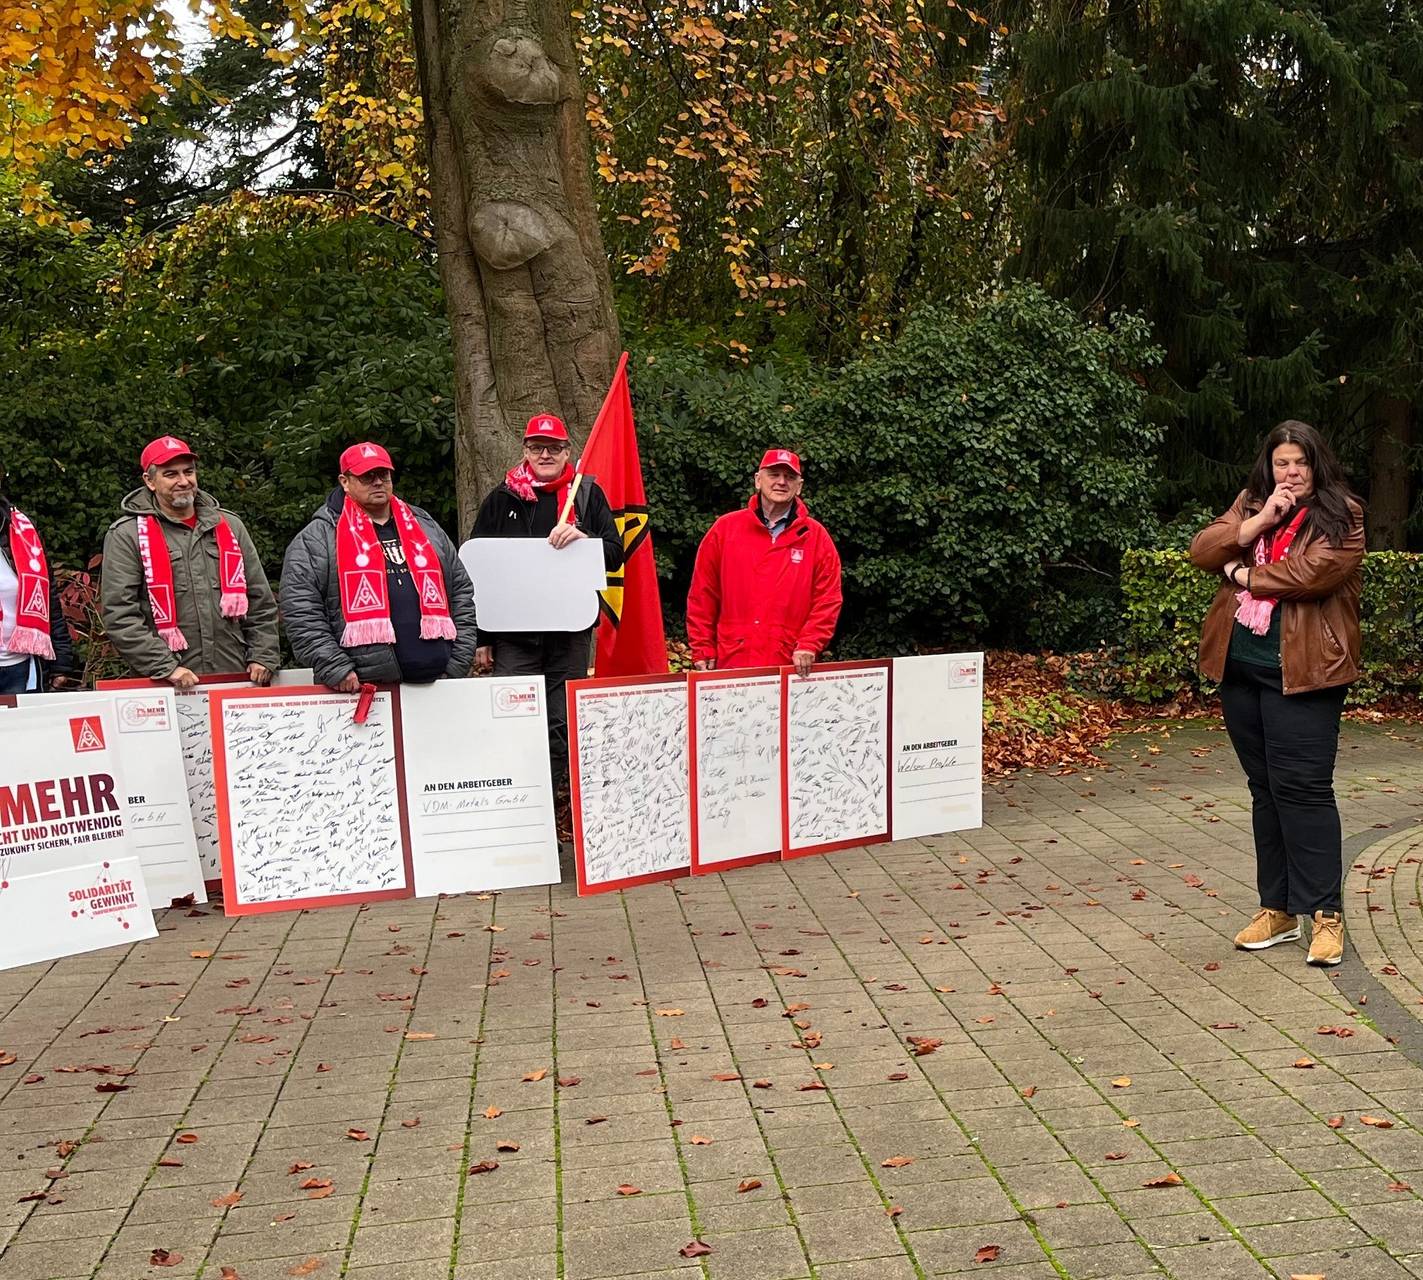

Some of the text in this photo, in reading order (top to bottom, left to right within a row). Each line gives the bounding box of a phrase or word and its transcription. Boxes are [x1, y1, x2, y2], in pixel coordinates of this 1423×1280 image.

[911, 743, 922, 751] DEN
[923, 739, 958, 749] ARBEITGEBER
[424, 778, 513, 792] AN DEN ARBEITGEBER
[0, 773, 120, 828] MEHR
[128, 795, 146, 805] BER
[495, 794, 528, 805] GmbH
[22, 826, 48, 842] UND
[50, 815, 122, 837] NOTWENDIG
[0, 829, 124, 856] ZUKUNFT SICHERN, FAIR BLEIBEN!
[68, 879, 132, 902] SOLIDARITÄT
[90, 892, 135, 910] GEWINNT
